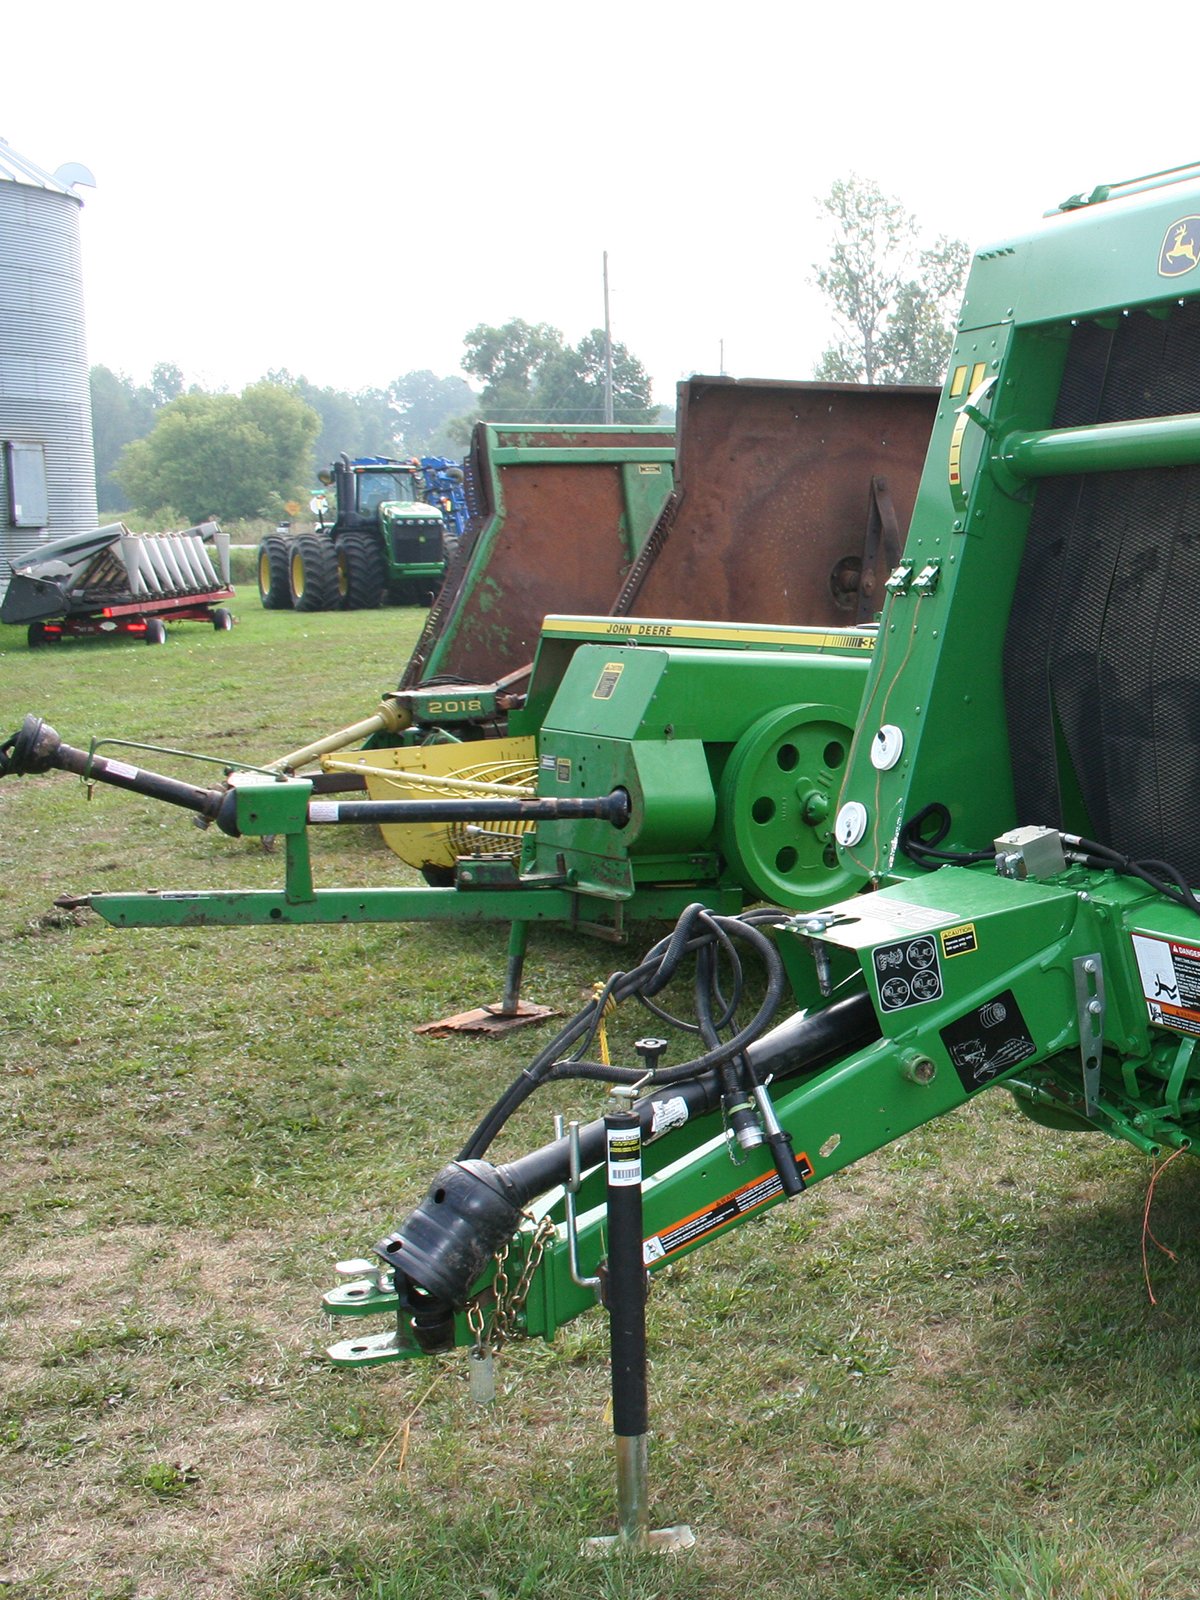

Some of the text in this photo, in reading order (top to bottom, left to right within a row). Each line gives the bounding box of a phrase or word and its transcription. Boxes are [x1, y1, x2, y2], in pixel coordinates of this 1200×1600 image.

[606, 624, 673, 636] JOHN DEERE
[428, 700, 481, 714] 2018
[947, 927, 972, 937] CAUTION
